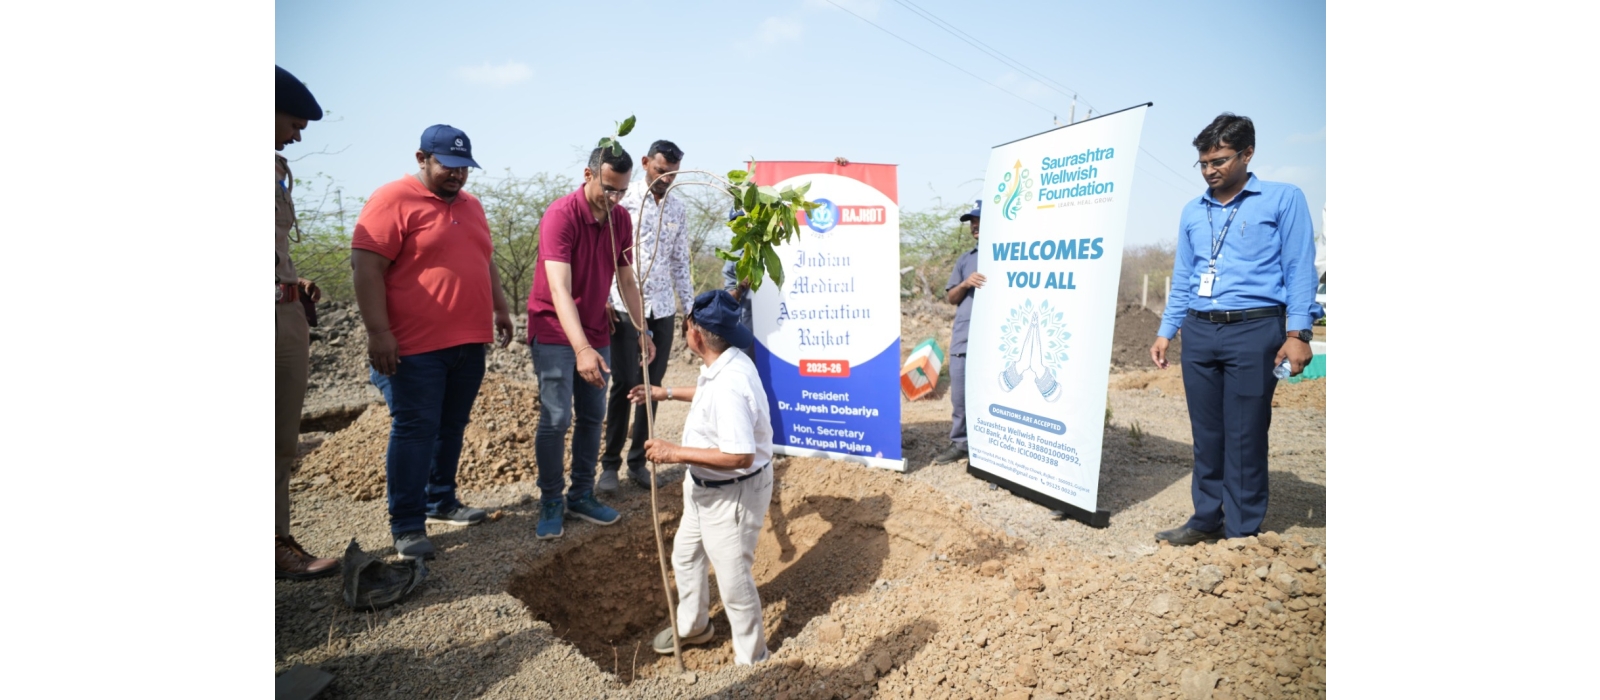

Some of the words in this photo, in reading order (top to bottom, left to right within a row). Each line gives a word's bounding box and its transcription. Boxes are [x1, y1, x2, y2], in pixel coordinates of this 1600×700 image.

[1042, 147, 1114, 170] Saurashtra
[1040, 165, 1097, 186] Wellwish
[1038, 181, 1114, 202] Foundation
[842, 208, 884, 222] RAJKOT
[992, 237, 1104, 261] WELCOMES
[792, 250, 850, 272] Indian
[790, 276, 854, 298] Medical
[1006, 272, 1041, 288] YOU
[1044, 272, 1076, 290] ALL
[776, 302, 870, 325] Association
[798, 328, 850, 350] Rajkot
[806, 362, 842, 374] 2025-26
[802, 390, 850, 402] President
[778, 401, 792, 410] Dr.
[794, 402, 828, 414] Jayesh
[830, 405, 879, 418] Dobariya
[992, 407, 1022, 420] DONATIONS
[1022, 416, 1033, 424] ARE
[1034, 418, 1062, 430] ACCEPTED
[793, 424, 815, 434] Hon.
[816, 426, 864, 440] Secretary
[974, 424, 986, 434] ICICI
[986, 428, 1002, 440] Bank,
[1002, 434, 1014, 443] A/c.
[1016, 438, 1026, 448] No.
[976, 418, 1006, 432] Saurashtra
[1008, 426, 1036, 442] Wellwish
[1036, 436, 1078, 456] Foundation,
[790, 436, 804, 445] Dr.
[806, 437, 837, 449] Krupal
[840, 440, 872, 452] Pujara
[988, 438, 998, 446] IFCI
[1000, 442, 1016, 452] Code:
[1018, 447, 1058, 466] ICIC0003388
